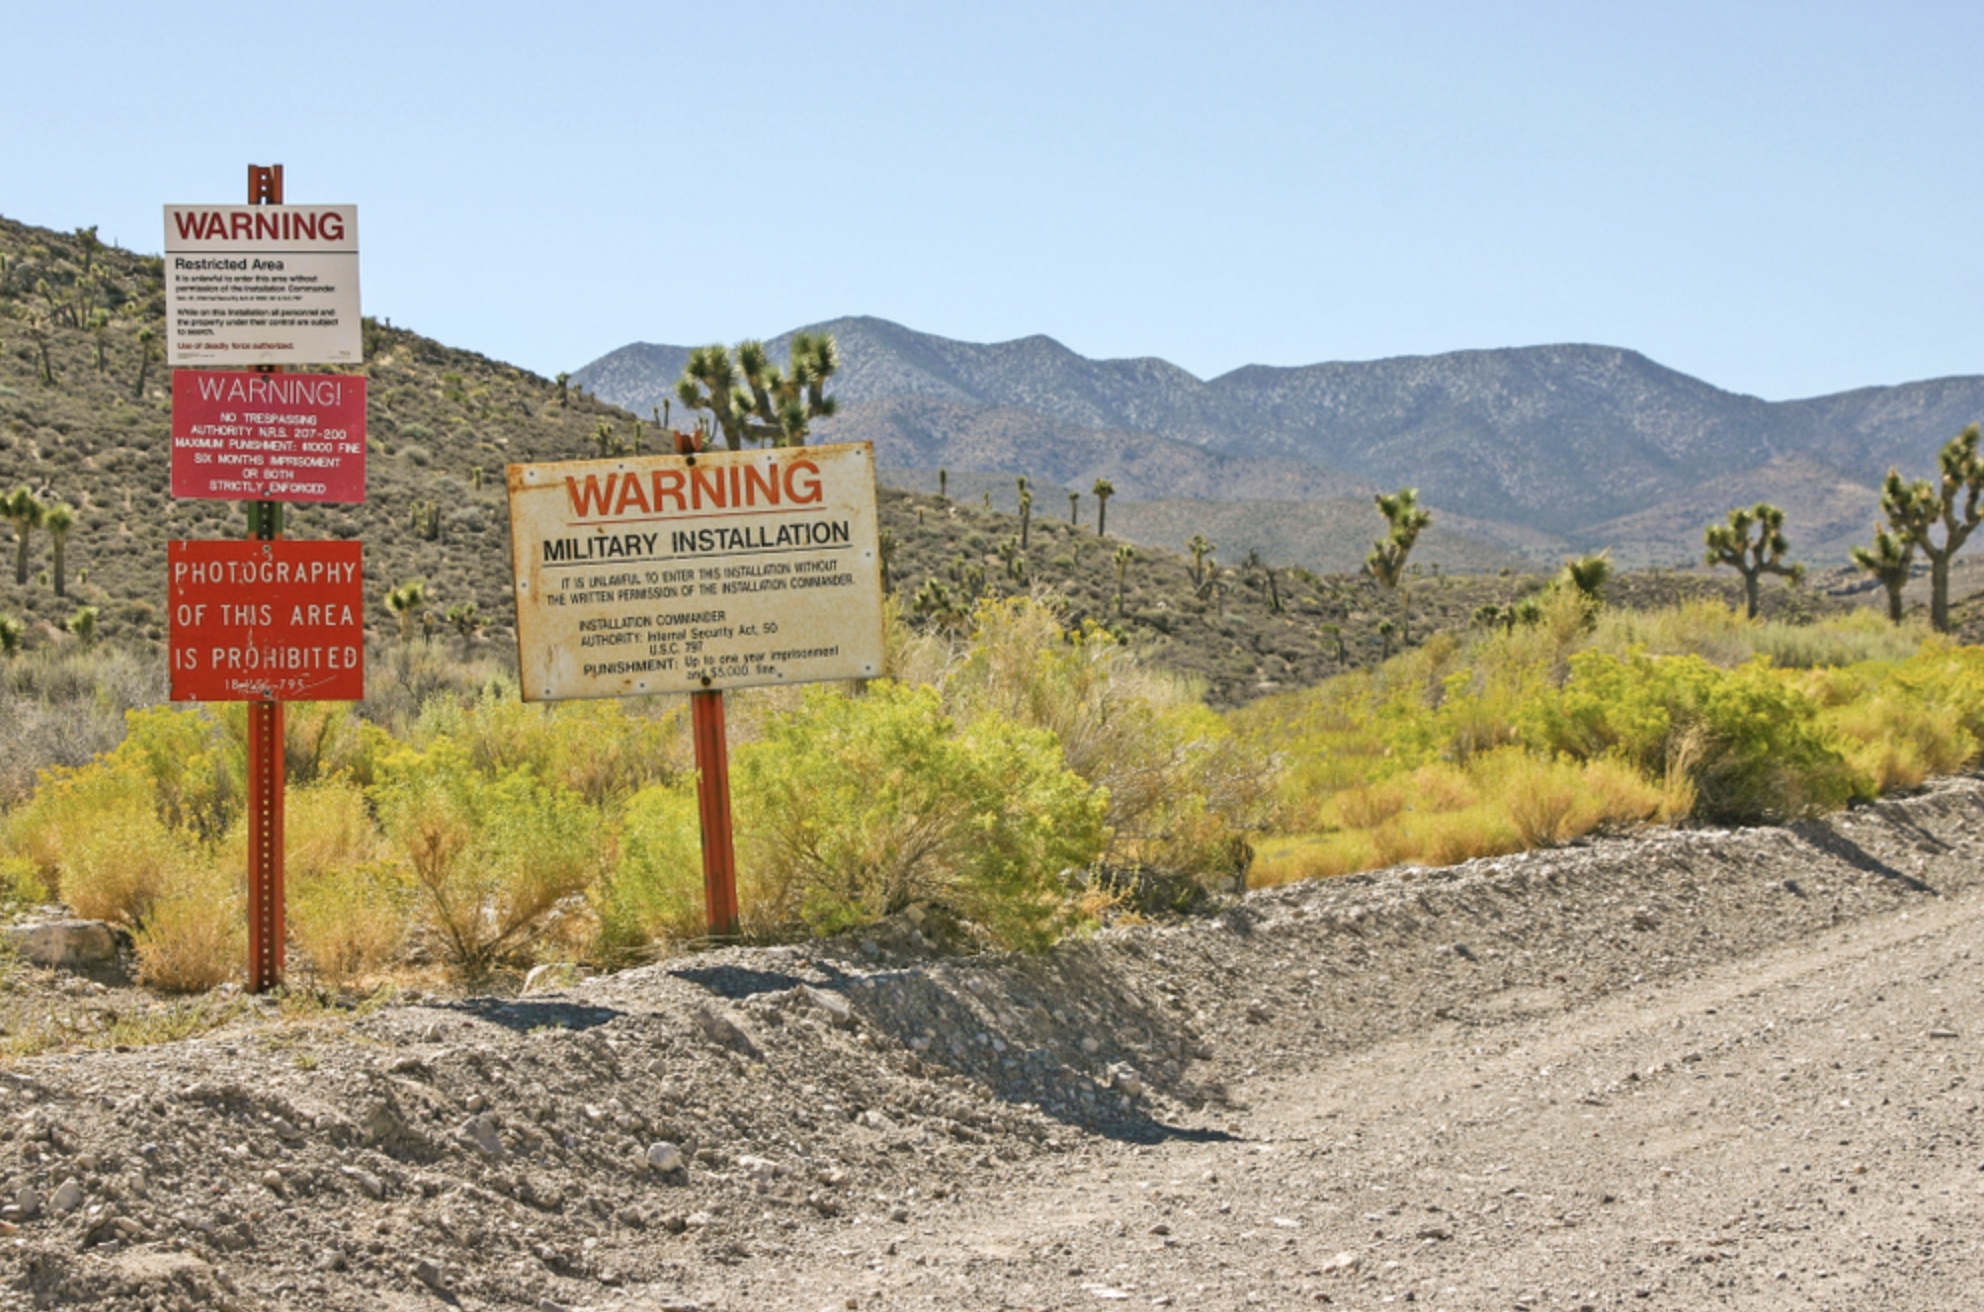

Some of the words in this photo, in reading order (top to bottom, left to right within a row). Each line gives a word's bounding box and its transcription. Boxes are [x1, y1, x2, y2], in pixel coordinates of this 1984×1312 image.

[174, 212, 344, 241] WARNING
[175, 258, 247, 270] Restricted
[251, 258, 285, 271] Area
[175, 285, 218, 293] permission
[177, 308, 198, 316] While
[212, 308, 226, 316] this
[320, 308, 335, 316] and
[191, 319, 225, 328] property
[311, 318, 339, 328] subject
[177, 342, 192, 350] Use
[194, 342, 202, 350] of
[205, 342, 229, 352] deadly
[232, 342, 251, 350] force
[197, 377, 342, 406] WARNING!
[220, 412, 236, 424] NO
[243, 413, 317, 426] TRESPASSING
[191, 425, 252, 436] AUTHORITY
[175, 437, 224, 449] MAXIMUM
[229, 439, 297, 452] PUNISHMENT:
[338, 443, 361, 454] FINE
[194, 452, 212, 464] SIX
[218, 454, 264, 466] MONTHS
[242, 468, 258, 479] OR
[264, 469, 294, 480] BOTH
[209, 479, 263, 493] STRICTLY
[269, 481, 326, 495] ENFORCED
[566, 460, 823, 518] WARNING
[543, 533, 658, 561] MILITARY
[672, 521, 849, 553] INSTALLATION
[175, 561, 356, 584] PHOTOGRAPHY
[561, 577, 570, 590] IT
[574, 577, 585, 589] IS
[589, 573, 641, 588] UNLAWFUL
[646, 571, 658, 584] TO
[662, 569, 694, 583] ENTER
[699, 567, 721, 580] THIS
[723, 562, 791, 578] INSTALLATION
[794, 559, 838, 573] WITHOUT
[547, 594, 566, 606] THE
[569, 590, 615, 605] WRITTEN
[618, 585, 678, 602] PERMISSION
[681, 584, 694, 597] OF
[699, 582, 717, 596] THE
[722, 578, 787, 595] INSTALLATION
[177, 604, 207, 626] OF
[220, 604, 272, 626] THIS
[290, 604, 354, 626] AREA
[579, 616, 652, 632] INSTALLATION
[656, 610, 726, 626] COMMANDER
[581, 632, 643, 648] AUTHORITY:
[647, 629, 686, 643] Internal
[691, 626, 734, 640] Security
[763, 622, 778, 634] 50
[175, 647, 197, 670] IS
[211, 646, 357, 669] PROHIBITED
[684, 655, 700, 669] Up
[704, 654, 715, 666] to
[719, 654, 738, 665] one
[743, 652, 764, 664] year
[583, 658, 679, 676] PUNISHMENT:
[687, 666, 706, 680] and
